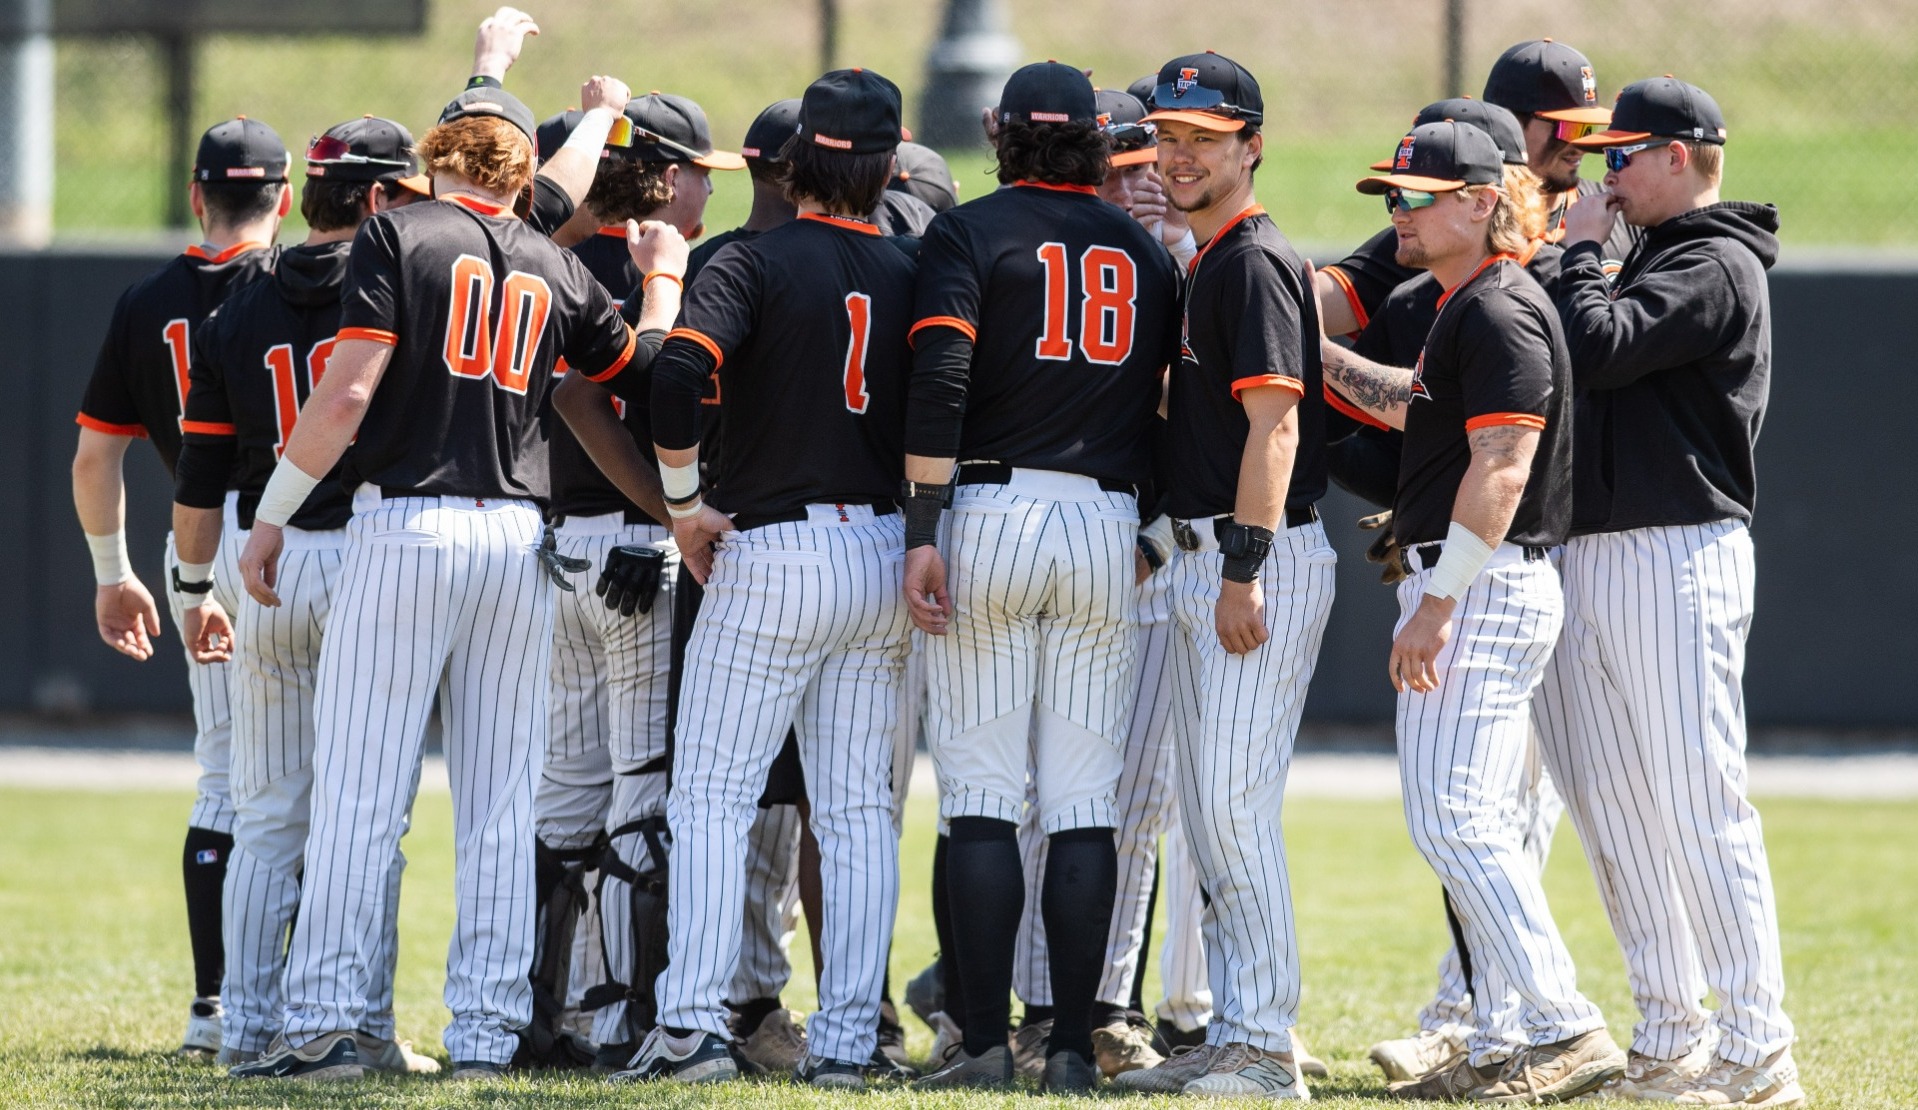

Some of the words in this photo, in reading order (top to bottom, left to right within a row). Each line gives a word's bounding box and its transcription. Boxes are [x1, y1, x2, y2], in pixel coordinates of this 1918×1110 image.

[814, 133, 852, 150] WARRIORS
[1031, 111, 1069, 122] WARRIORS
[442, 253, 554, 397] 00
[843, 291, 872, 415] 1
[1035, 241, 1138, 367] 18
